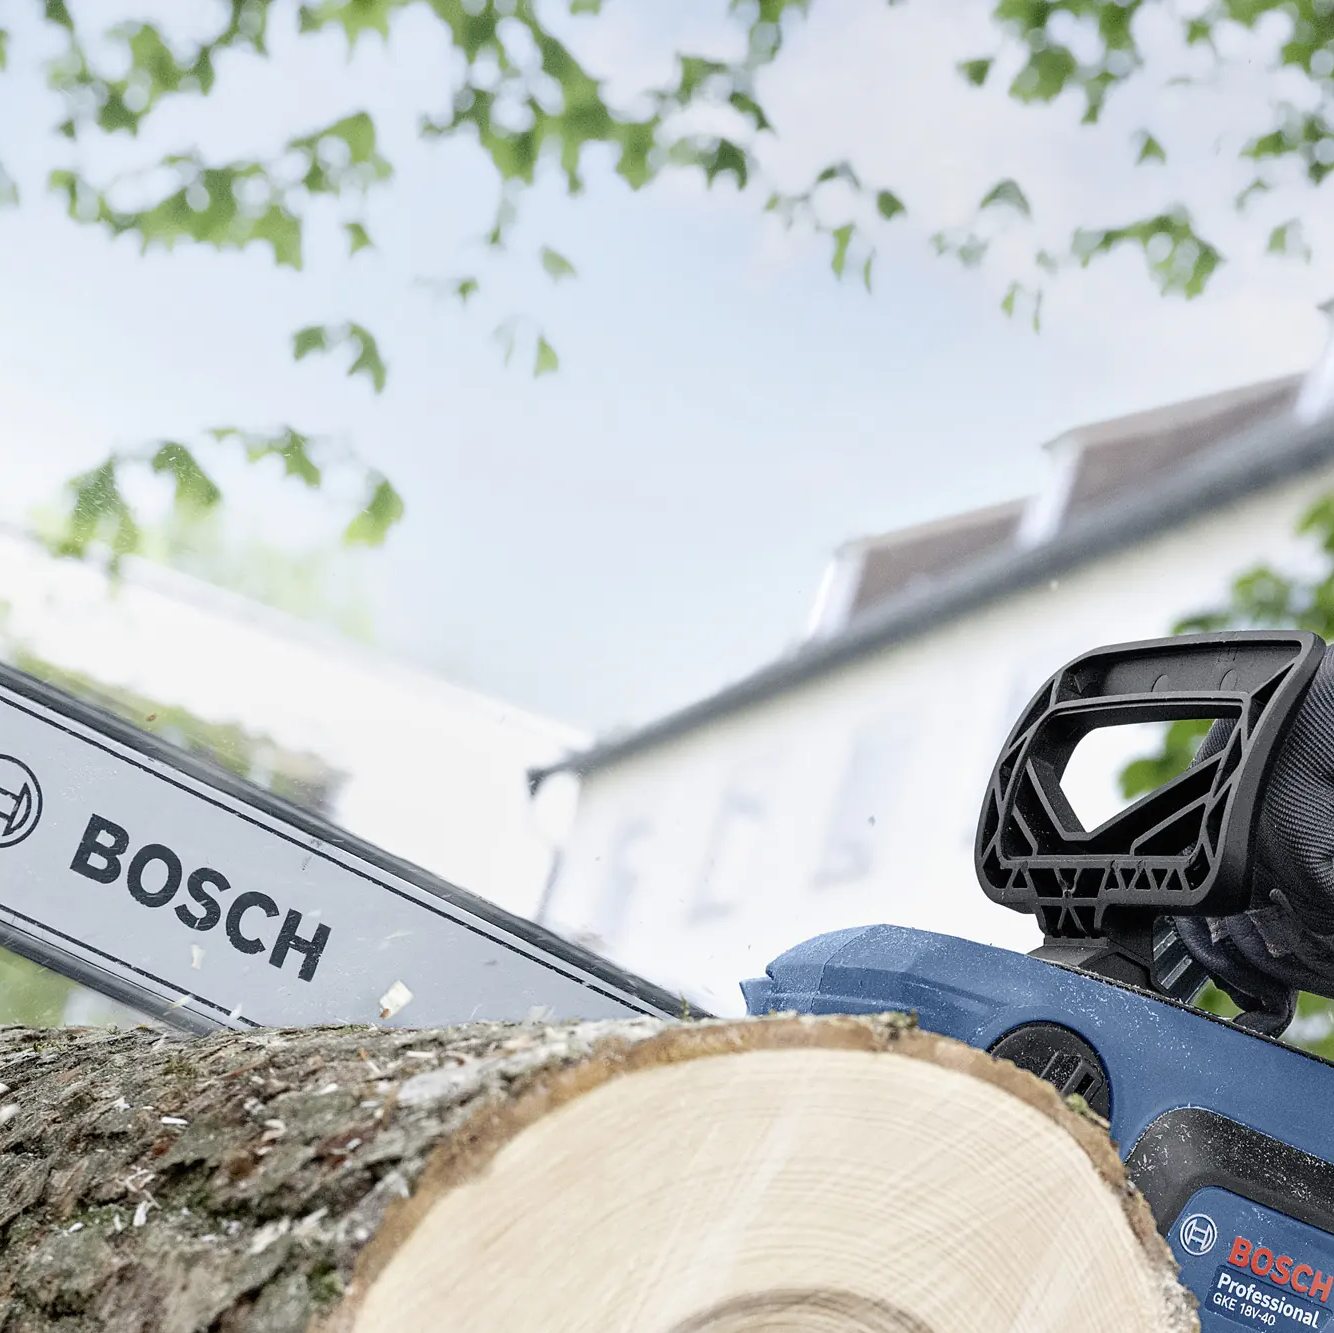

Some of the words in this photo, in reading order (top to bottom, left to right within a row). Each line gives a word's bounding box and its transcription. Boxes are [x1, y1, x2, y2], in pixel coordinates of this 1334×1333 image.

[69, 813, 332, 982] BOSCH
[1216, 1272, 1320, 1329] Professional
[1227, 1236, 1334, 1303] BOSCH
[1212, 1292, 1238, 1311] GKE
[1240, 1303, 1276, 1326] 18V-40
